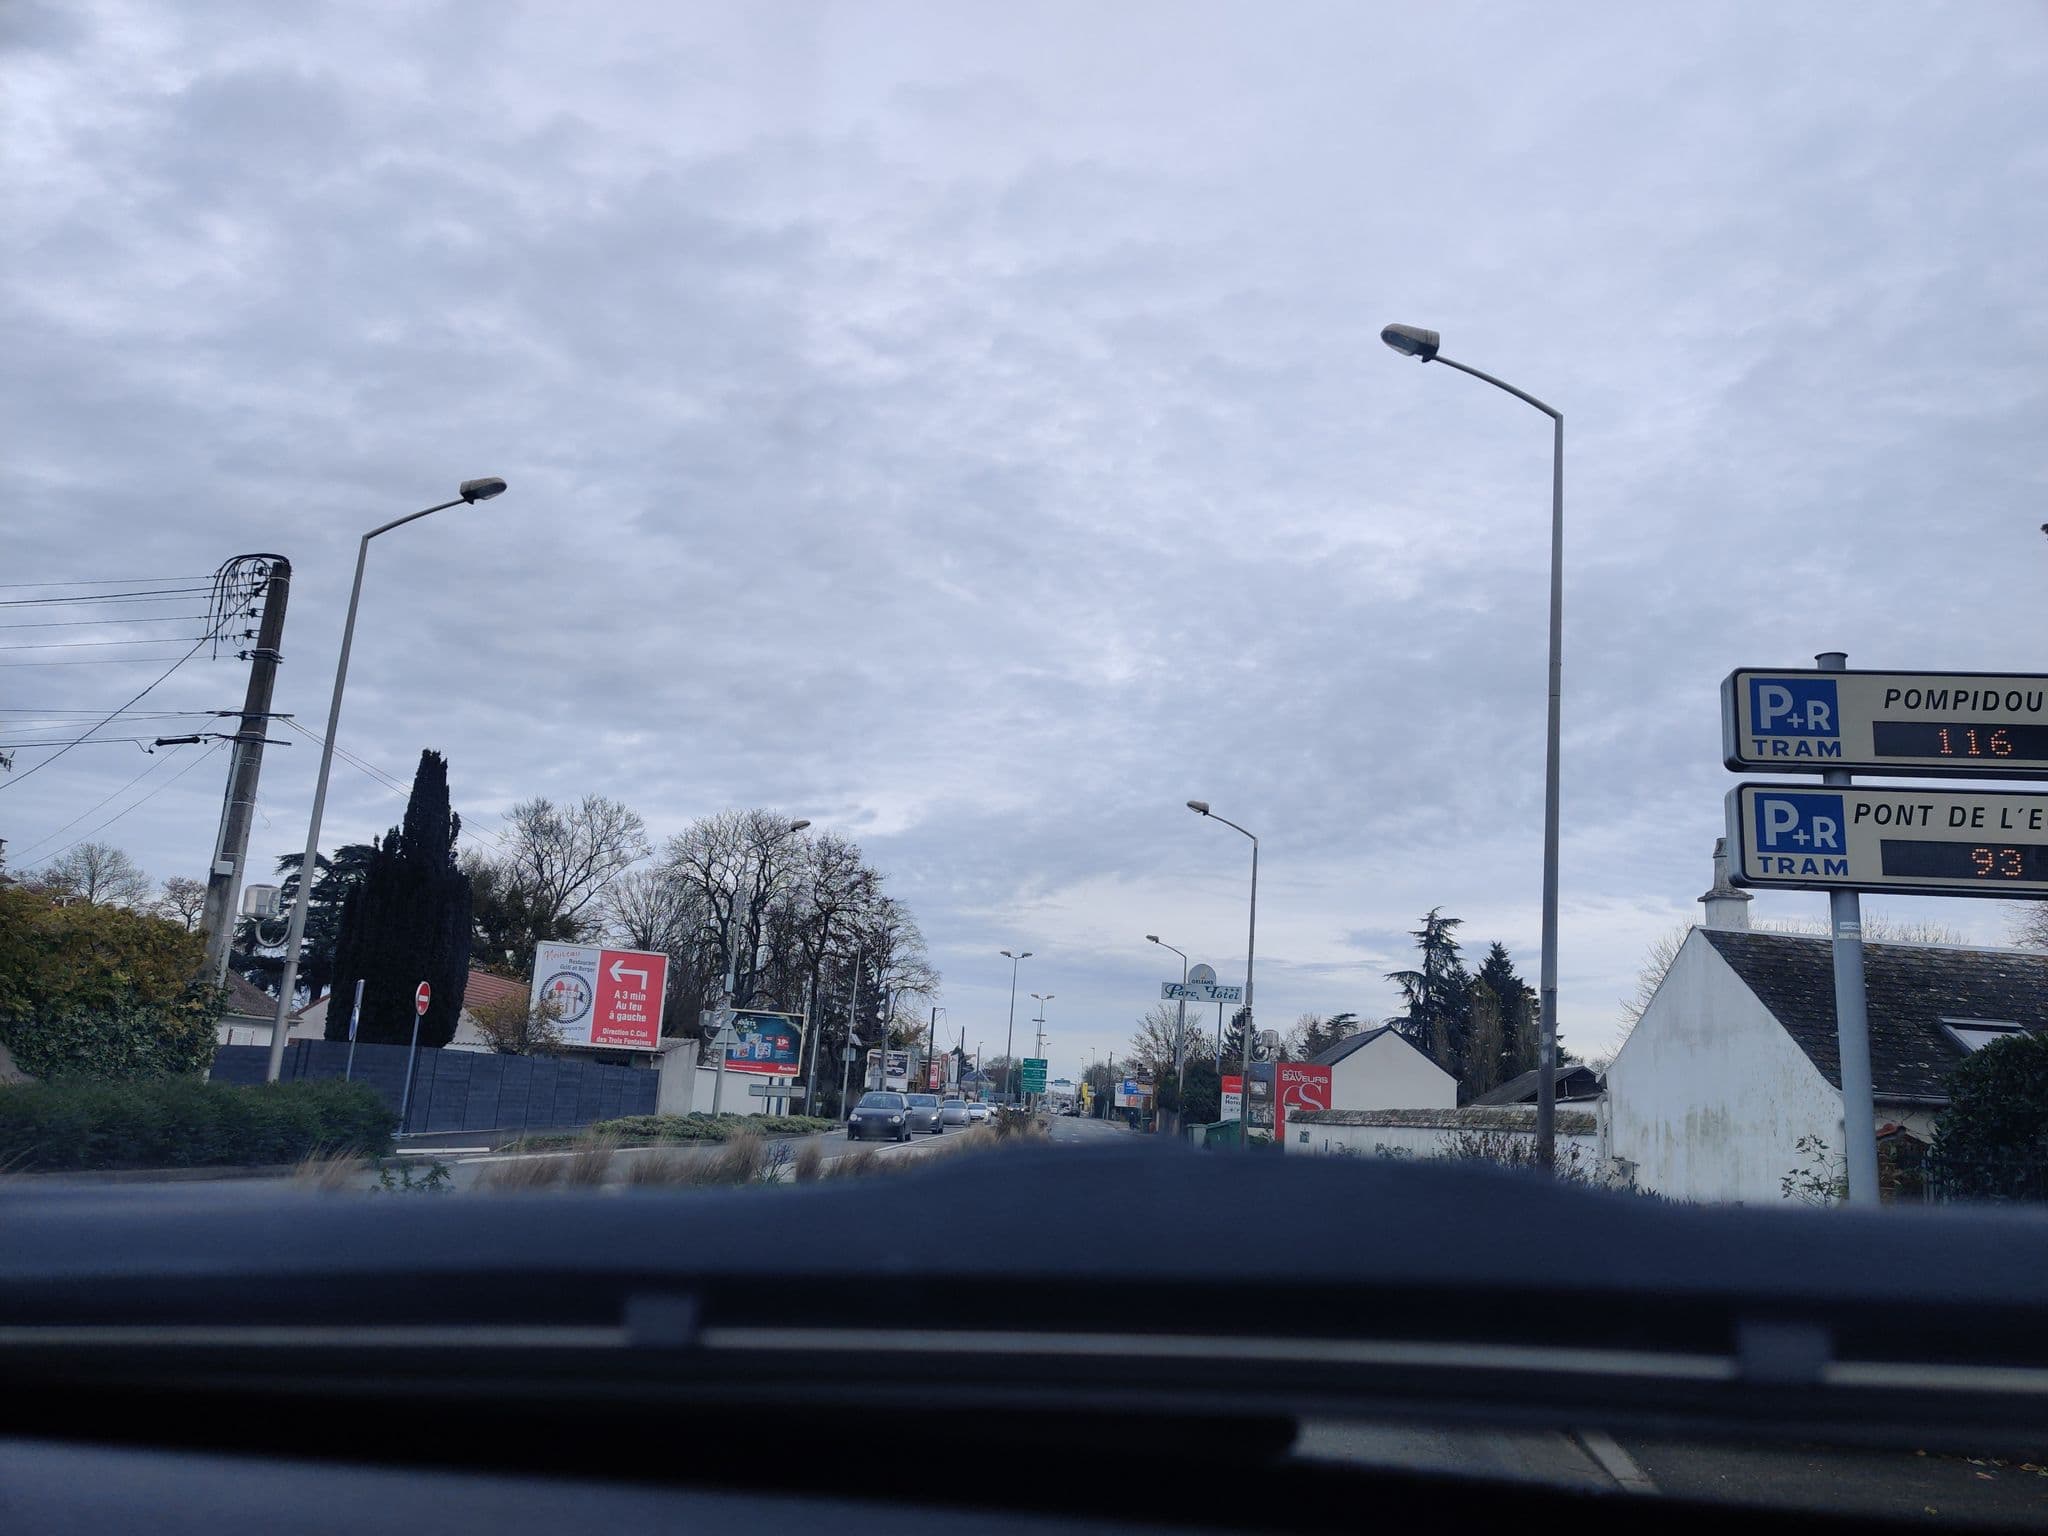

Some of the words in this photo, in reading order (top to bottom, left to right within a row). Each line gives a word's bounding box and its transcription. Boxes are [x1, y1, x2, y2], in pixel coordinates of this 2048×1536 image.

[1884, 688, 2043, 712] POMPIDOU
[1752, 739, 1842, 758] TRAM
[1938, 728, 2013, 756] 116
[1854, 803, 1934, 827] PONT
[1949, 806, 1986, 828] DE
[2000, 807, 2048, 830] L'E
[1757, 856, 1849, 877] TRAM
[1971, 848, 2023, 877] 93
[614, 989, 621, 999] A
[622, 990, 628, 1000] 3
[630, 991, 646, 1001] min
[616, 1000, 627, 1010] Au
[629, 1002, 642, 1011] feu
[616, 1011, 647, 1022] gauche
[1282, 1073, 1329, 1084] SAVEURS
